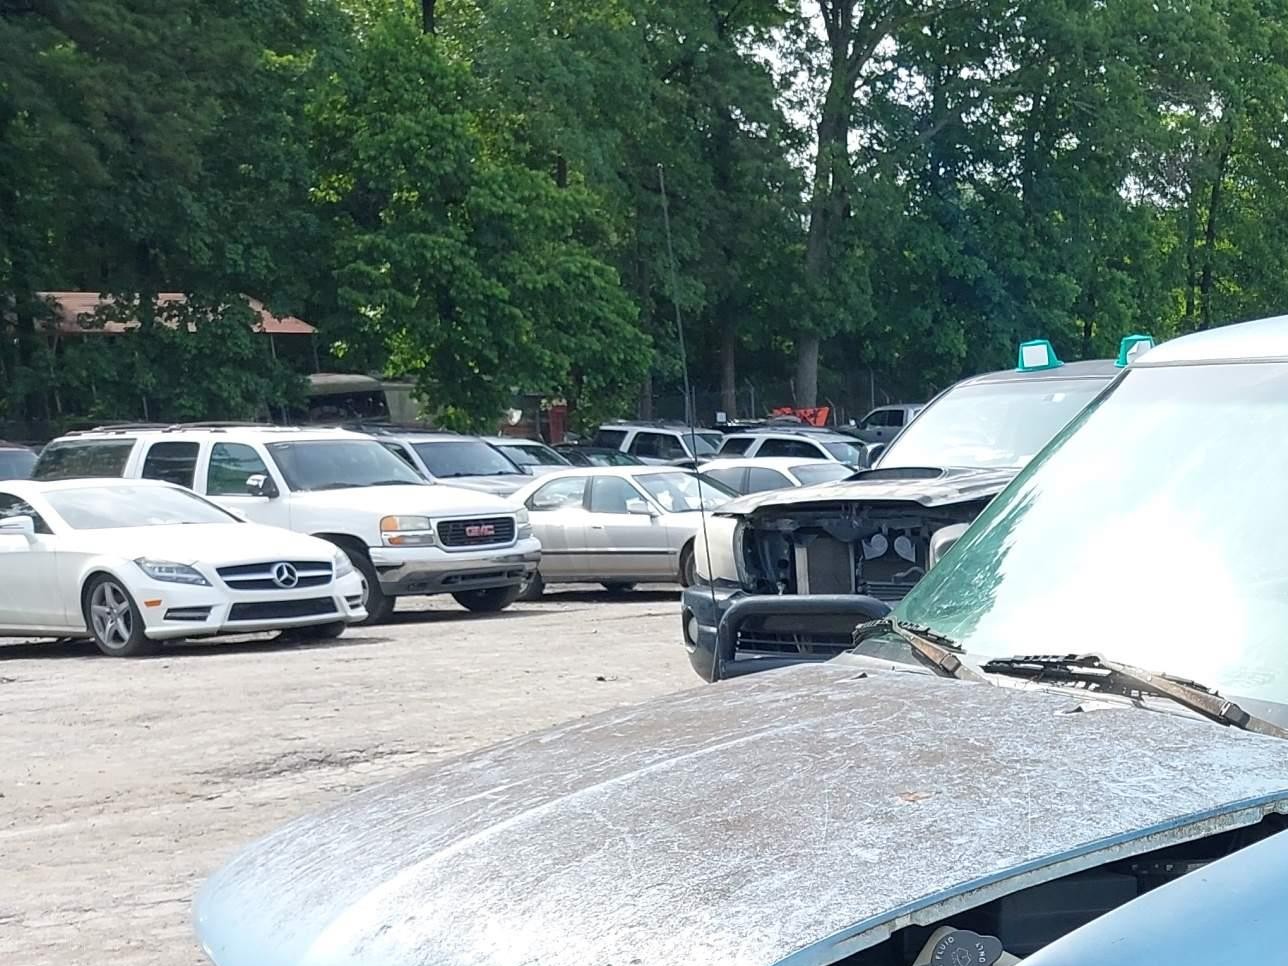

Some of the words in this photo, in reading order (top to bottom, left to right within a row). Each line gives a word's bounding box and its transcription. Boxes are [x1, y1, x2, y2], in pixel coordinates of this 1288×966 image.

[465, 524, 496, 537] GMC
[935, 936, 955, 960] FLUID
[975, 942, 986, 963] ONLY
